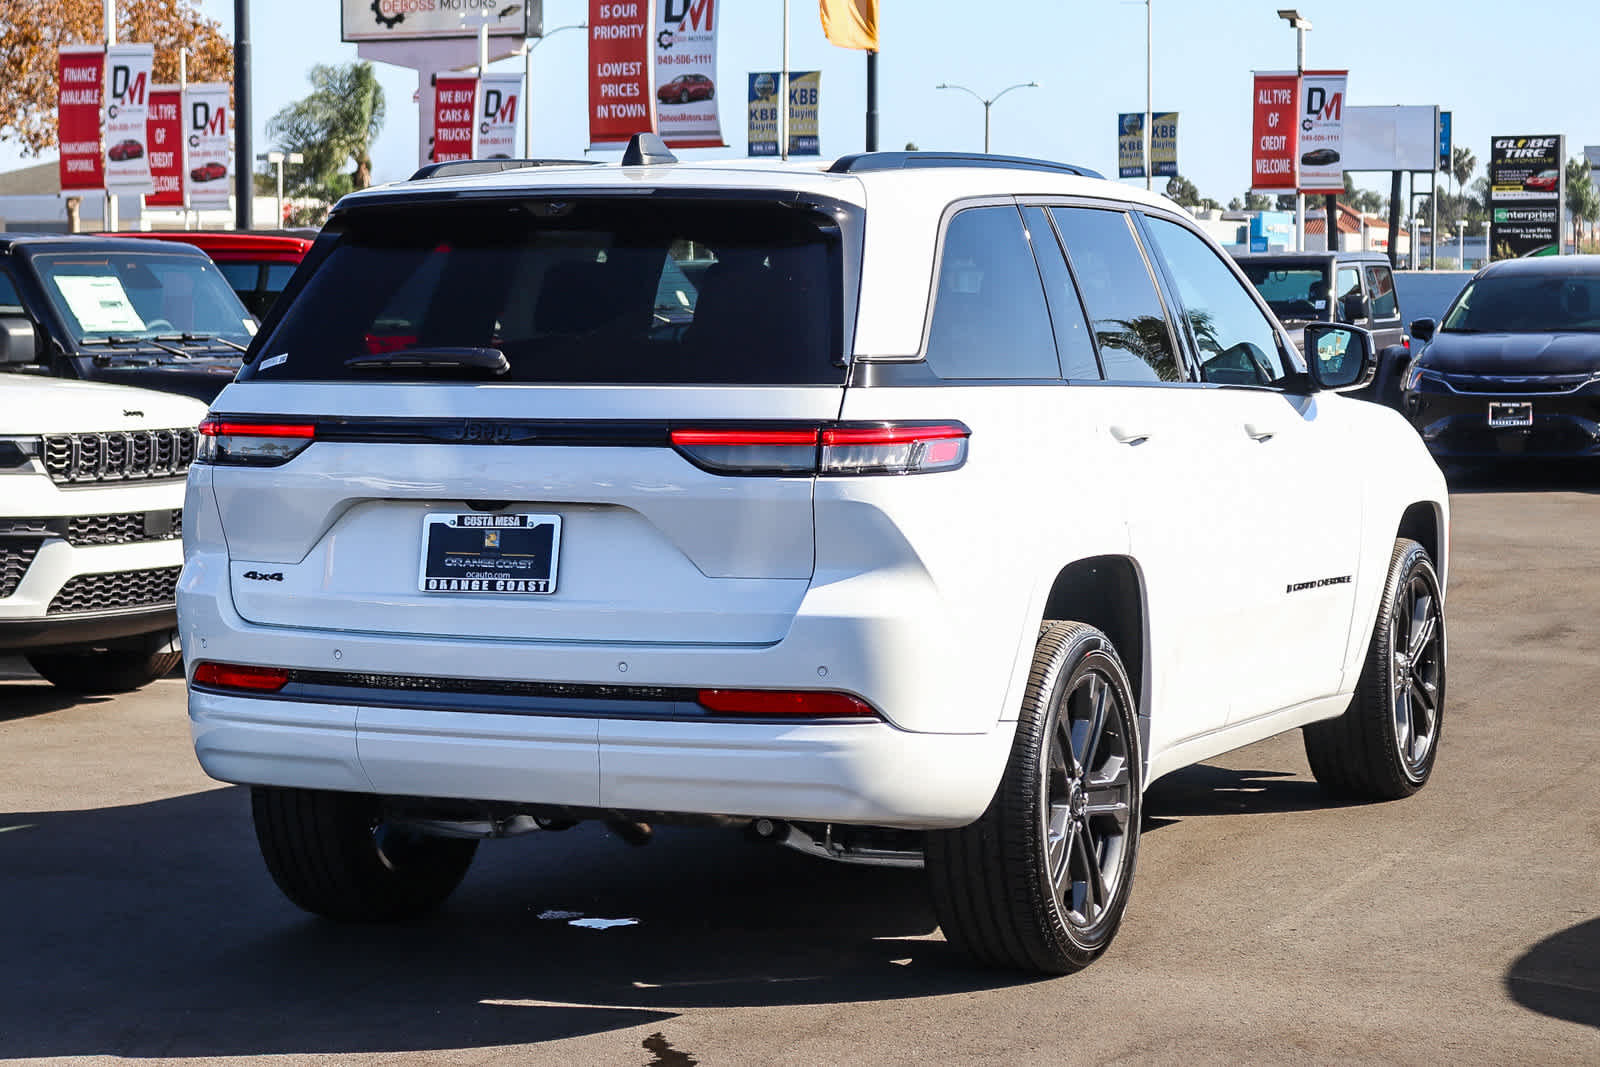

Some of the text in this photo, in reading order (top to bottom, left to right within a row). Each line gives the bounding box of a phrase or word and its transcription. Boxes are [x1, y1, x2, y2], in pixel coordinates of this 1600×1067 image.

[440, 0, 497, 9] MOTORS
[600, 3, 638, 19] IS OUR
[593, 24, 645, 41] PRIORITY
[63, 67, 97, 82] FINANCE
[597, 61, 642, 77] LOWEST
[61, 88, 100, 105] AVAILABLE
[440, 89, 474, 103] WE BUY
[601, 82, 640, 97] PRICES
[790, 88, 818, 105] KBB
[1258, 88, 1291, 105] ALL TYPE
[160, 103, 177, 121] TYPE
[439, 108, 471, 123] CARS &
[597, 103, 646, 119] IN TOWN
[749, 108, 778, 121] KBB
[790, 108, 818, 121] Buying
[1267, 112, 1280, 128] OF
[154, 127, 166, 144] OF
[438, 127, 471, 142] TRUCKS
[1152, 125, 1177, 139] KBB
[1260, 135, 1287, 151] CREDIT
[1495, 138, 1557, 149] GLOBE
[149, 152, 174, 169] CREDIT
[1505, 148, 1547, 159] TIRE
[1255, 159, 1291, 175] WELCOME
[455, 417, 513, 443] Jeep
[463, 516, 521, 527] COSTA MESA
[444, 557, 534, 570] ORANGE COAST
[242, 570, 284, 582] 4x4
[465, 571, 511, 580] ocauto.com
[428, 579, 547, 592] ORANGE COAST
